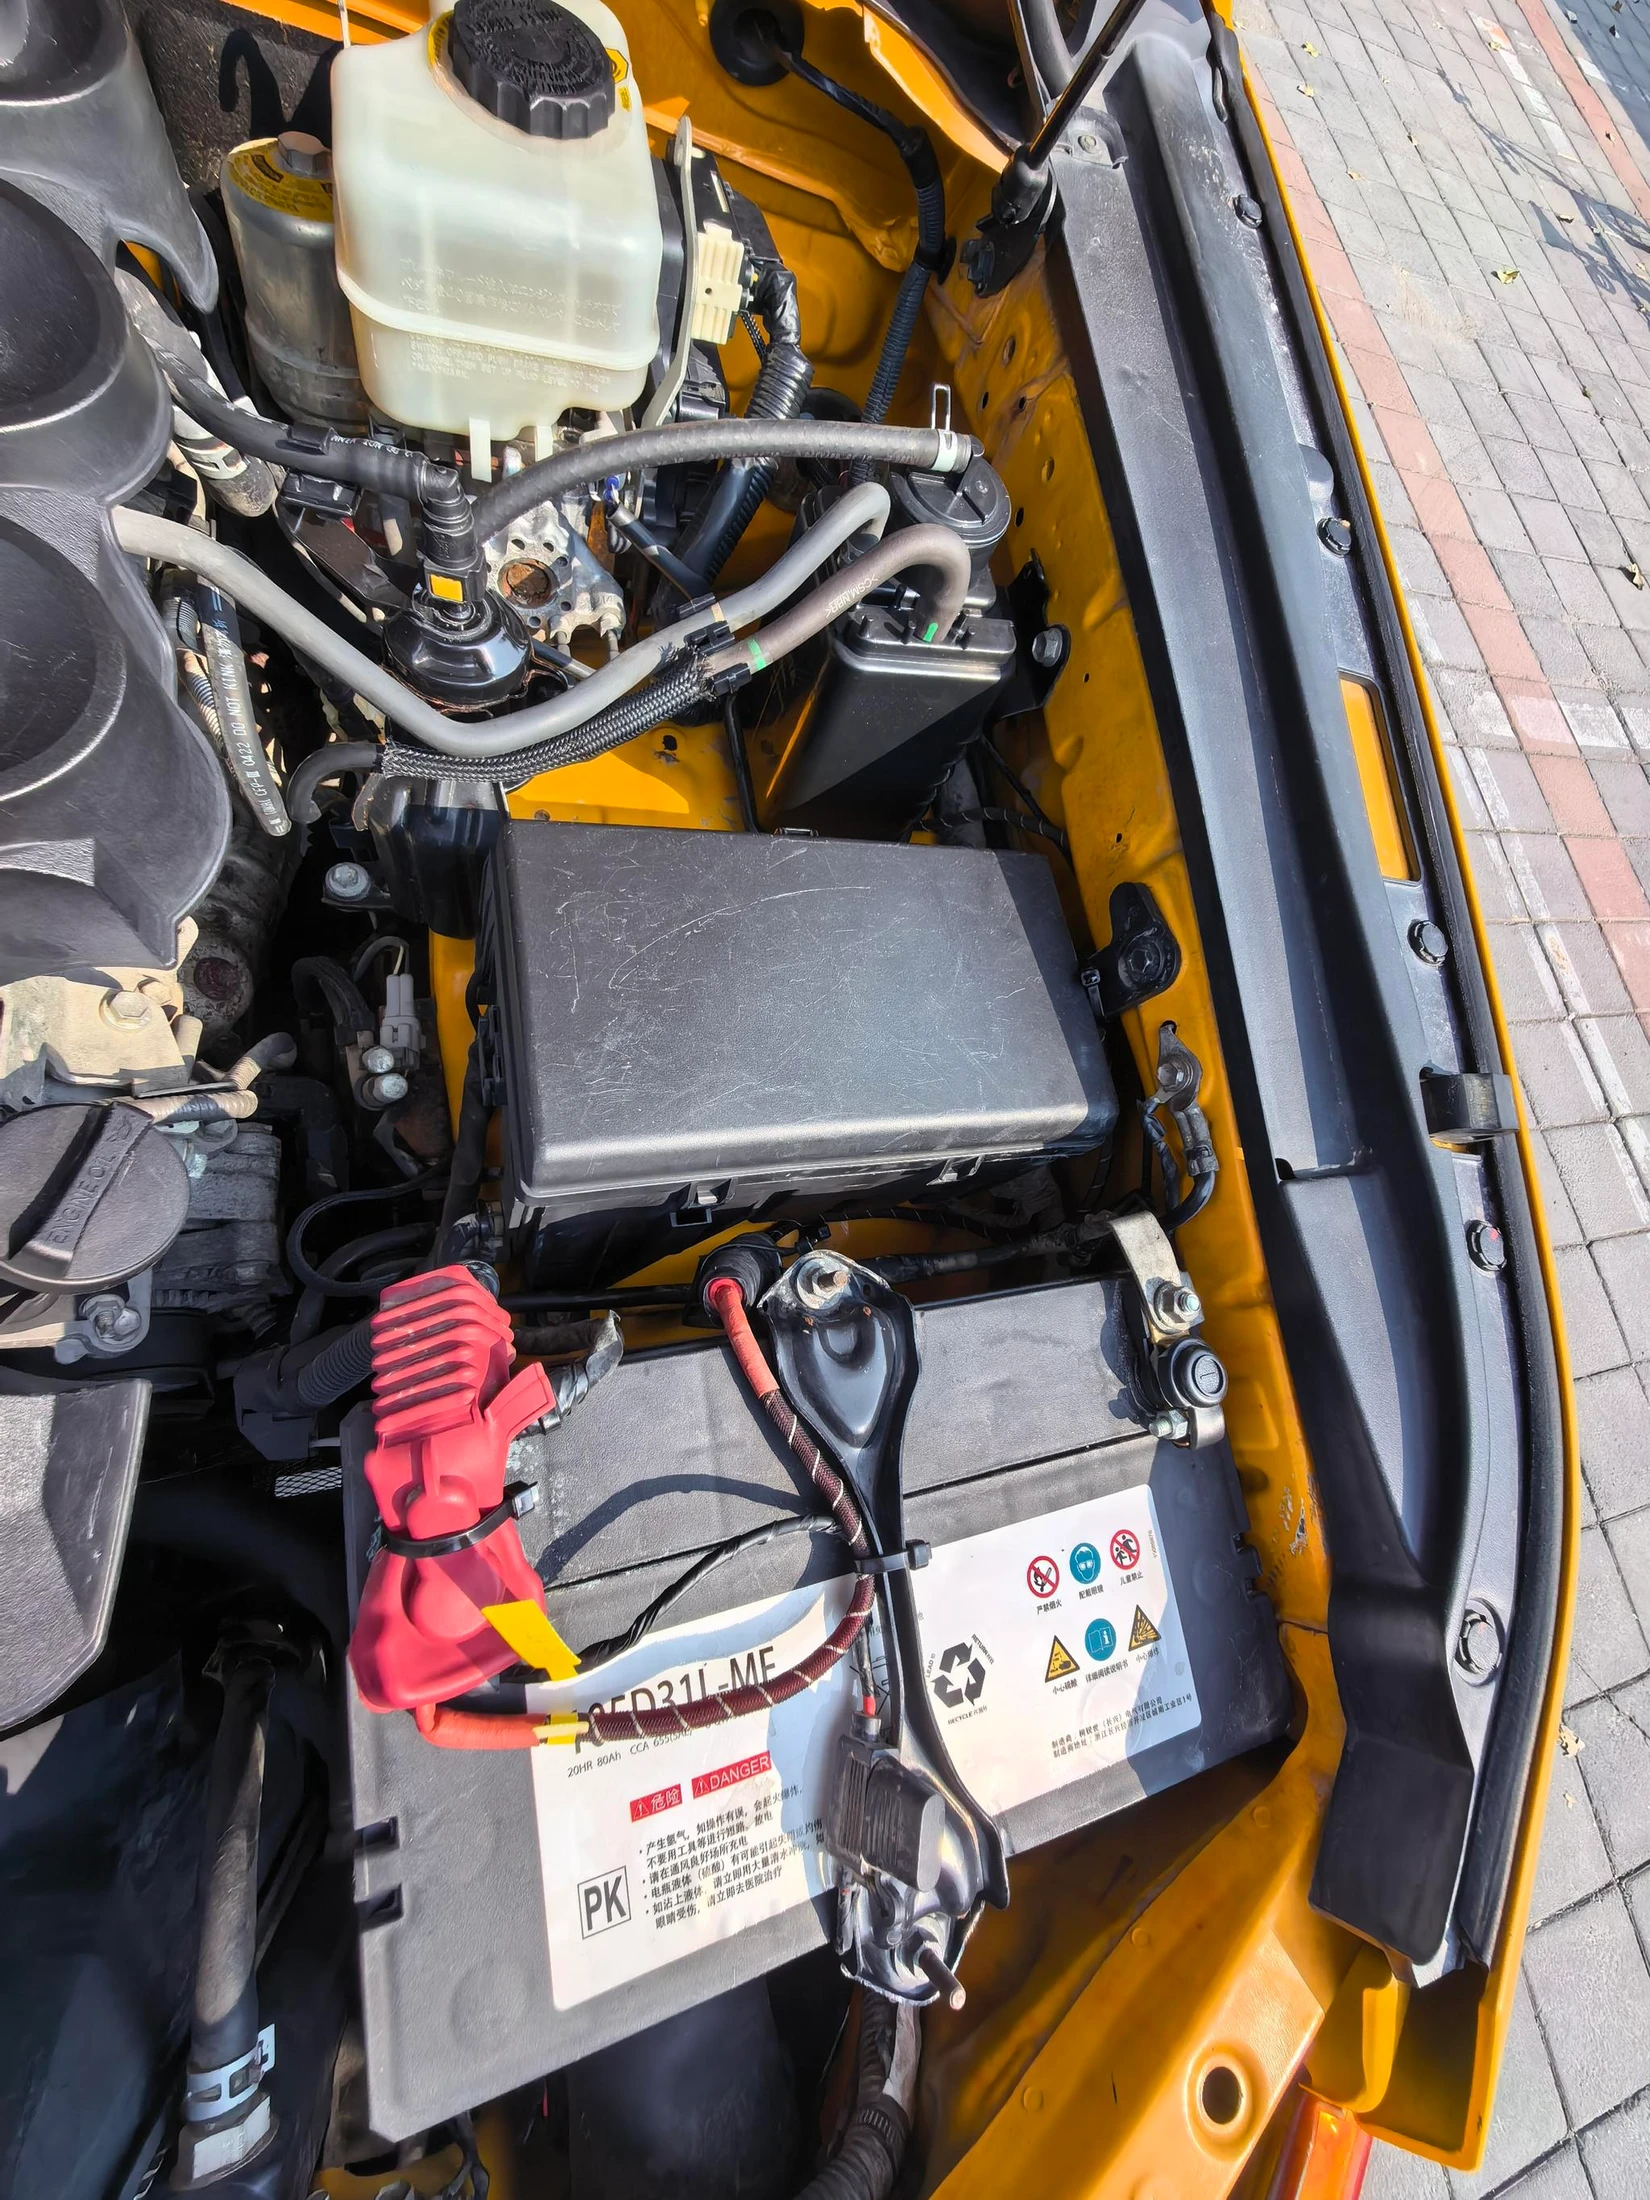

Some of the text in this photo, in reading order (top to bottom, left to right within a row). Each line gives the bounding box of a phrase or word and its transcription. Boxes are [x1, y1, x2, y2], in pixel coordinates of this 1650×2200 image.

[220, 663, 238, 690] KINK
[227, 697, 243, 717] NOT
[232, 722, 246, 736] DO
[567, 1760, 594, 1778] 20HR
[597, 1751, 622, 1768] 80Ah
[630, 1740, 651, 1756] CCA
[650, 1756, 771, 1811] 危险 DANGER
[584, 1878, 626, 1931] PK
